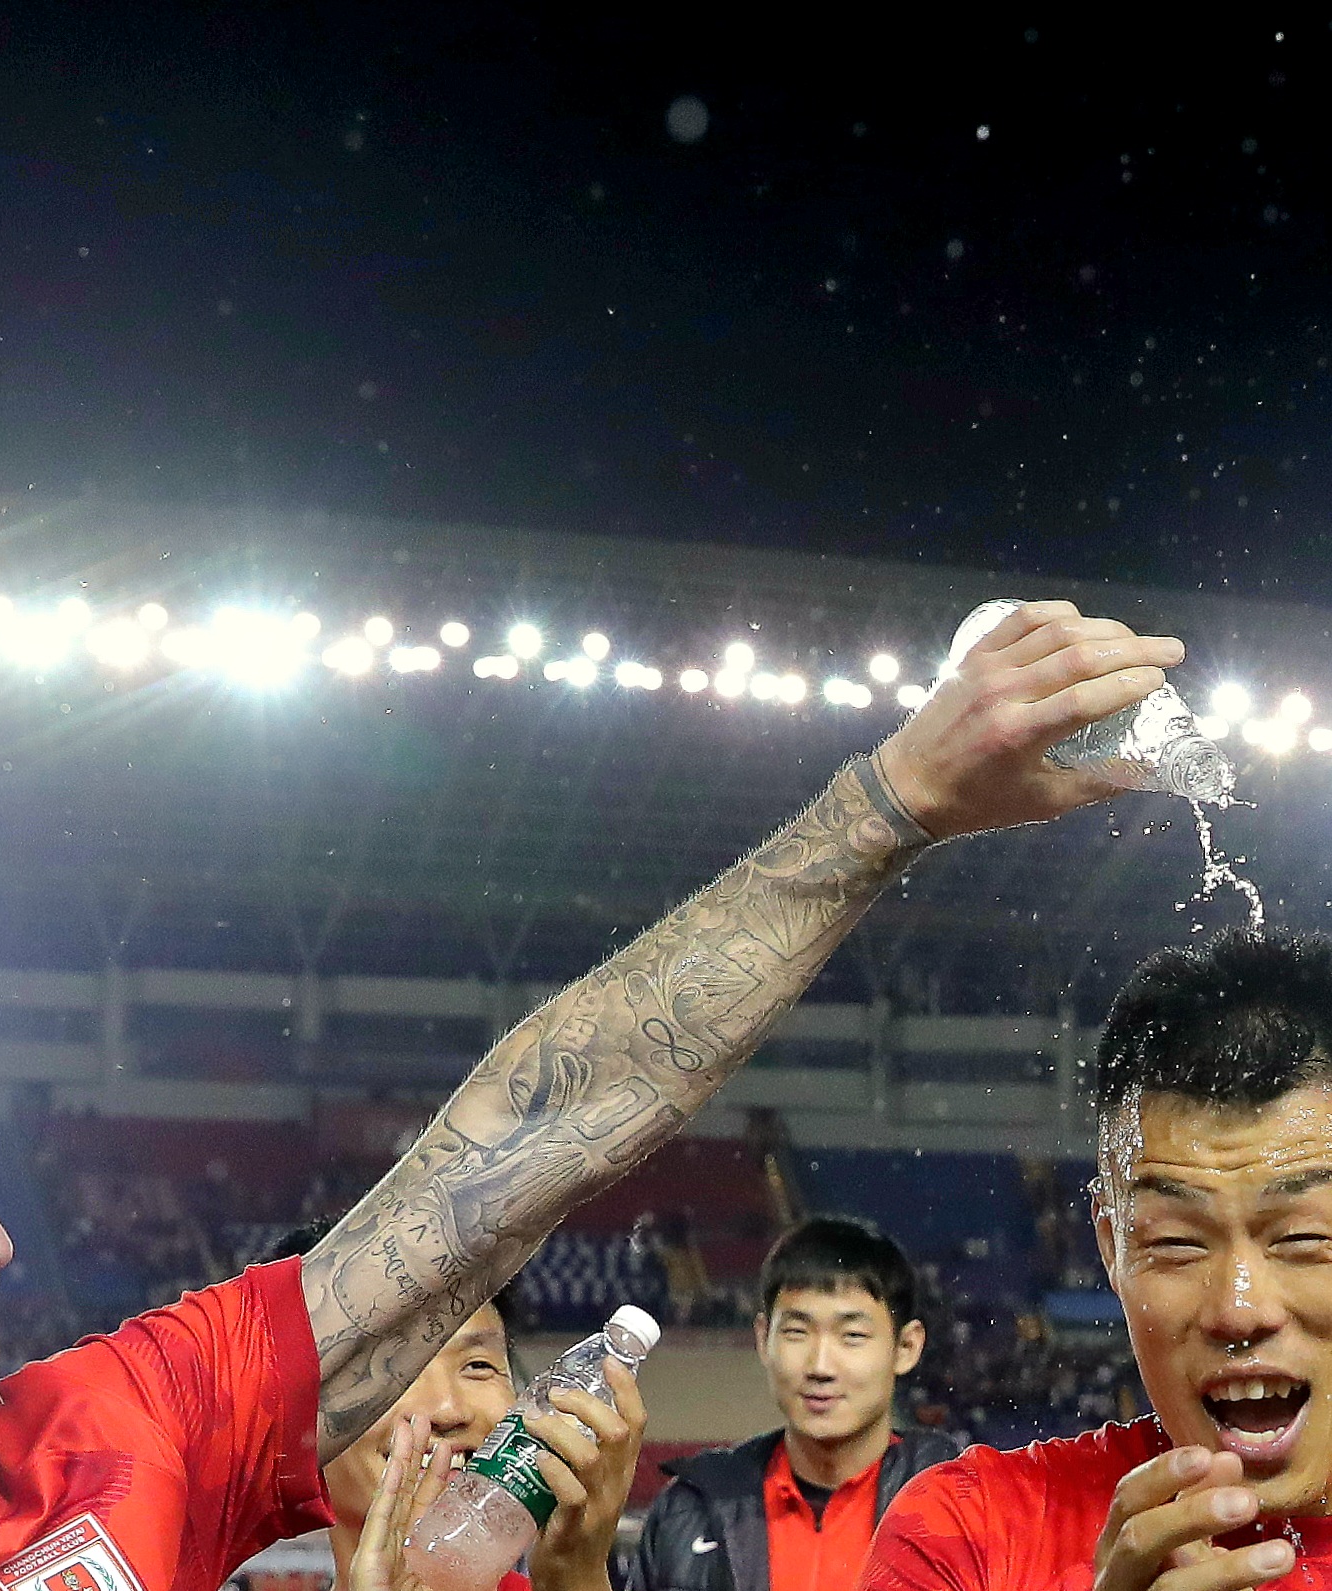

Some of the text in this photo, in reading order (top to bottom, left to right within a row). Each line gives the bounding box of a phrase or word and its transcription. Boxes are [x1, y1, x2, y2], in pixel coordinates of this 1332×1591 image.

[3, 1526, 86, 1575] CHANGCHUN YATAI
[13, 1535, 86, 1577] FOOTBALL CLUB
